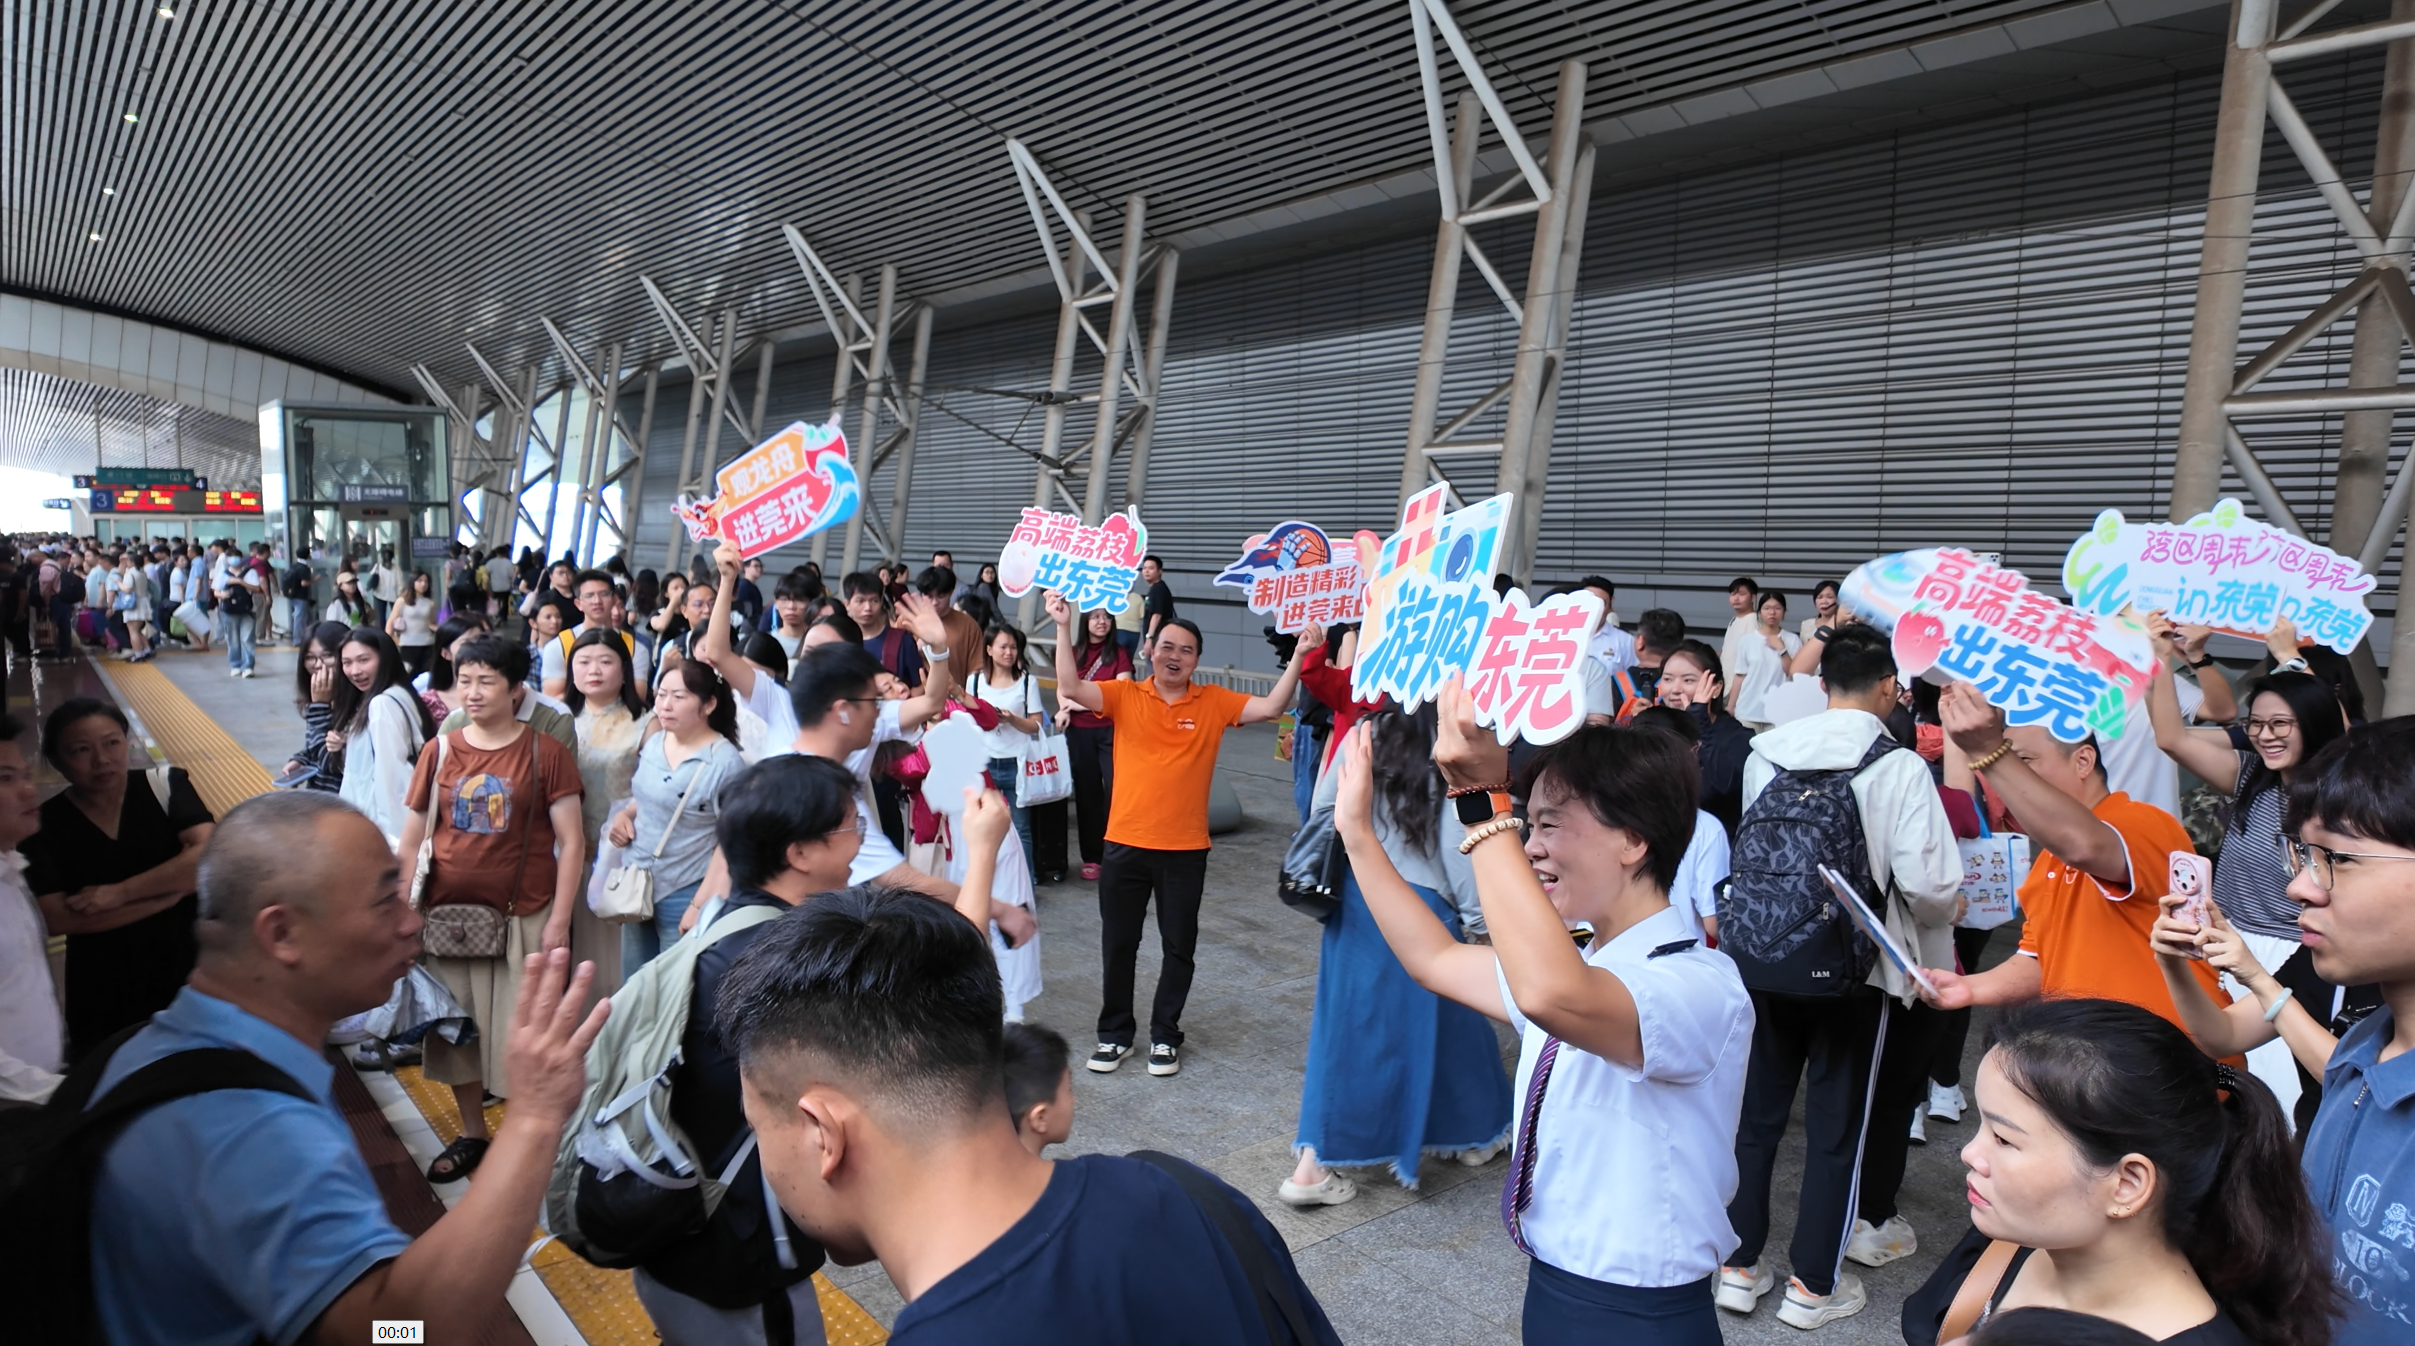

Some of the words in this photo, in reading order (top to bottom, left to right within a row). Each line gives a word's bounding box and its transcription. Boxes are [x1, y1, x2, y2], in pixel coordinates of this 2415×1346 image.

[78, 477, 86, 488] 3
[196, 479, 203, 489] 4
[729, 441, 796, 500] 观龙舟
[96, 492, 107, 508] 3
[733, 482, 819, 552] 进莞来
[1011, 508, 1125, 565] 高端荔枝
[1033, 553, 1137, 613] 出东莞
[1253, 564, 1358, 608] 制造精彩
[1913, 550, 2097, 663] 高端荔枝
[1938, 624, 2108, 741] 出东莞
[1811, 970, 1831, 978] L&M
